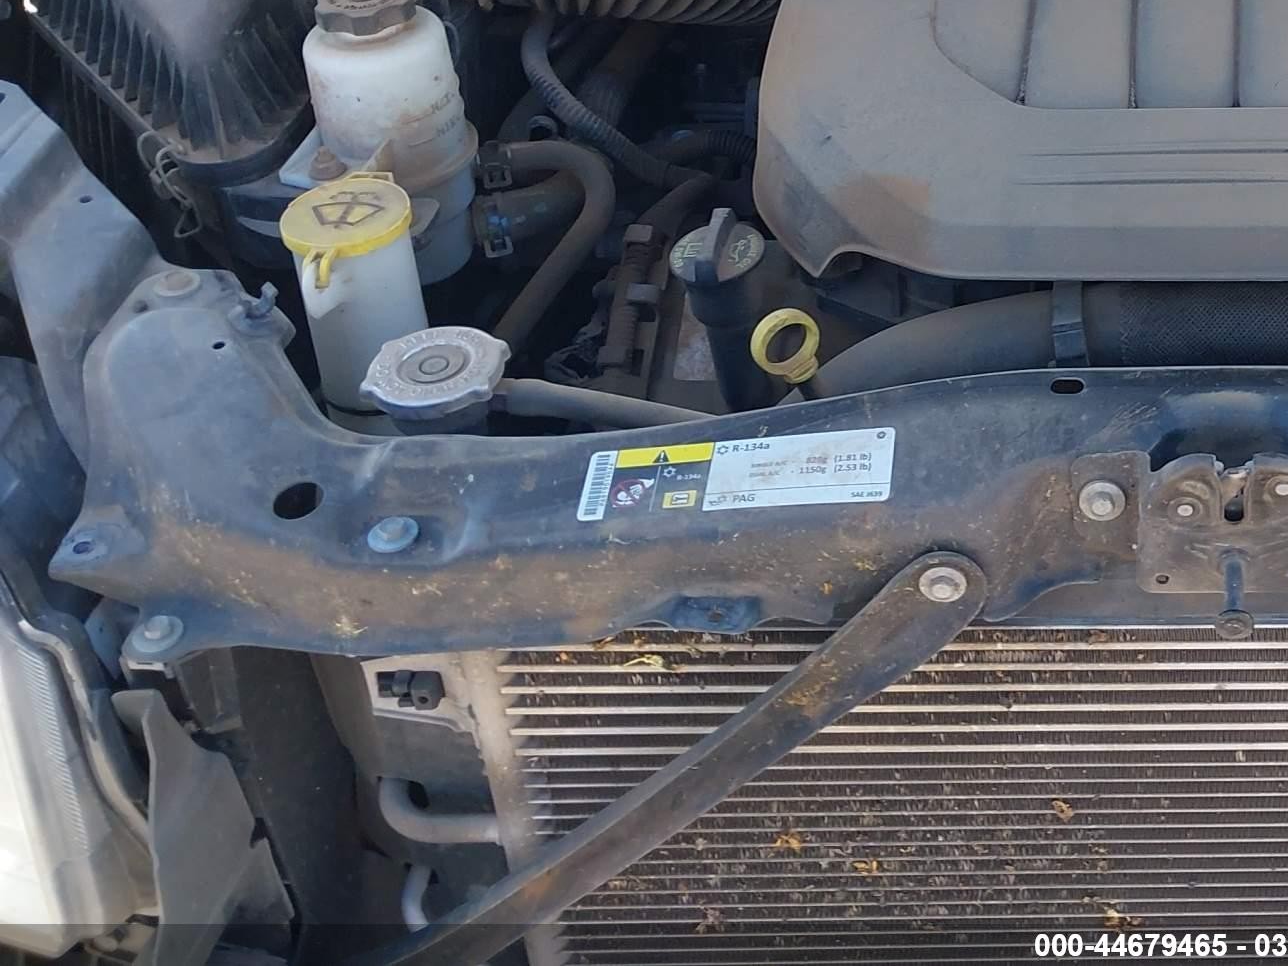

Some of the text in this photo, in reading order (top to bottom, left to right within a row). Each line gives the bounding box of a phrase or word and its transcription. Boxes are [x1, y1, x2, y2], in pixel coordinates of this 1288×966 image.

[732, 441, 770, 453] R-134a
[859, 451, 873, 462] lb)
[859, 461, 873, 472] lb)
[732, 494, 755, 508] PAG
